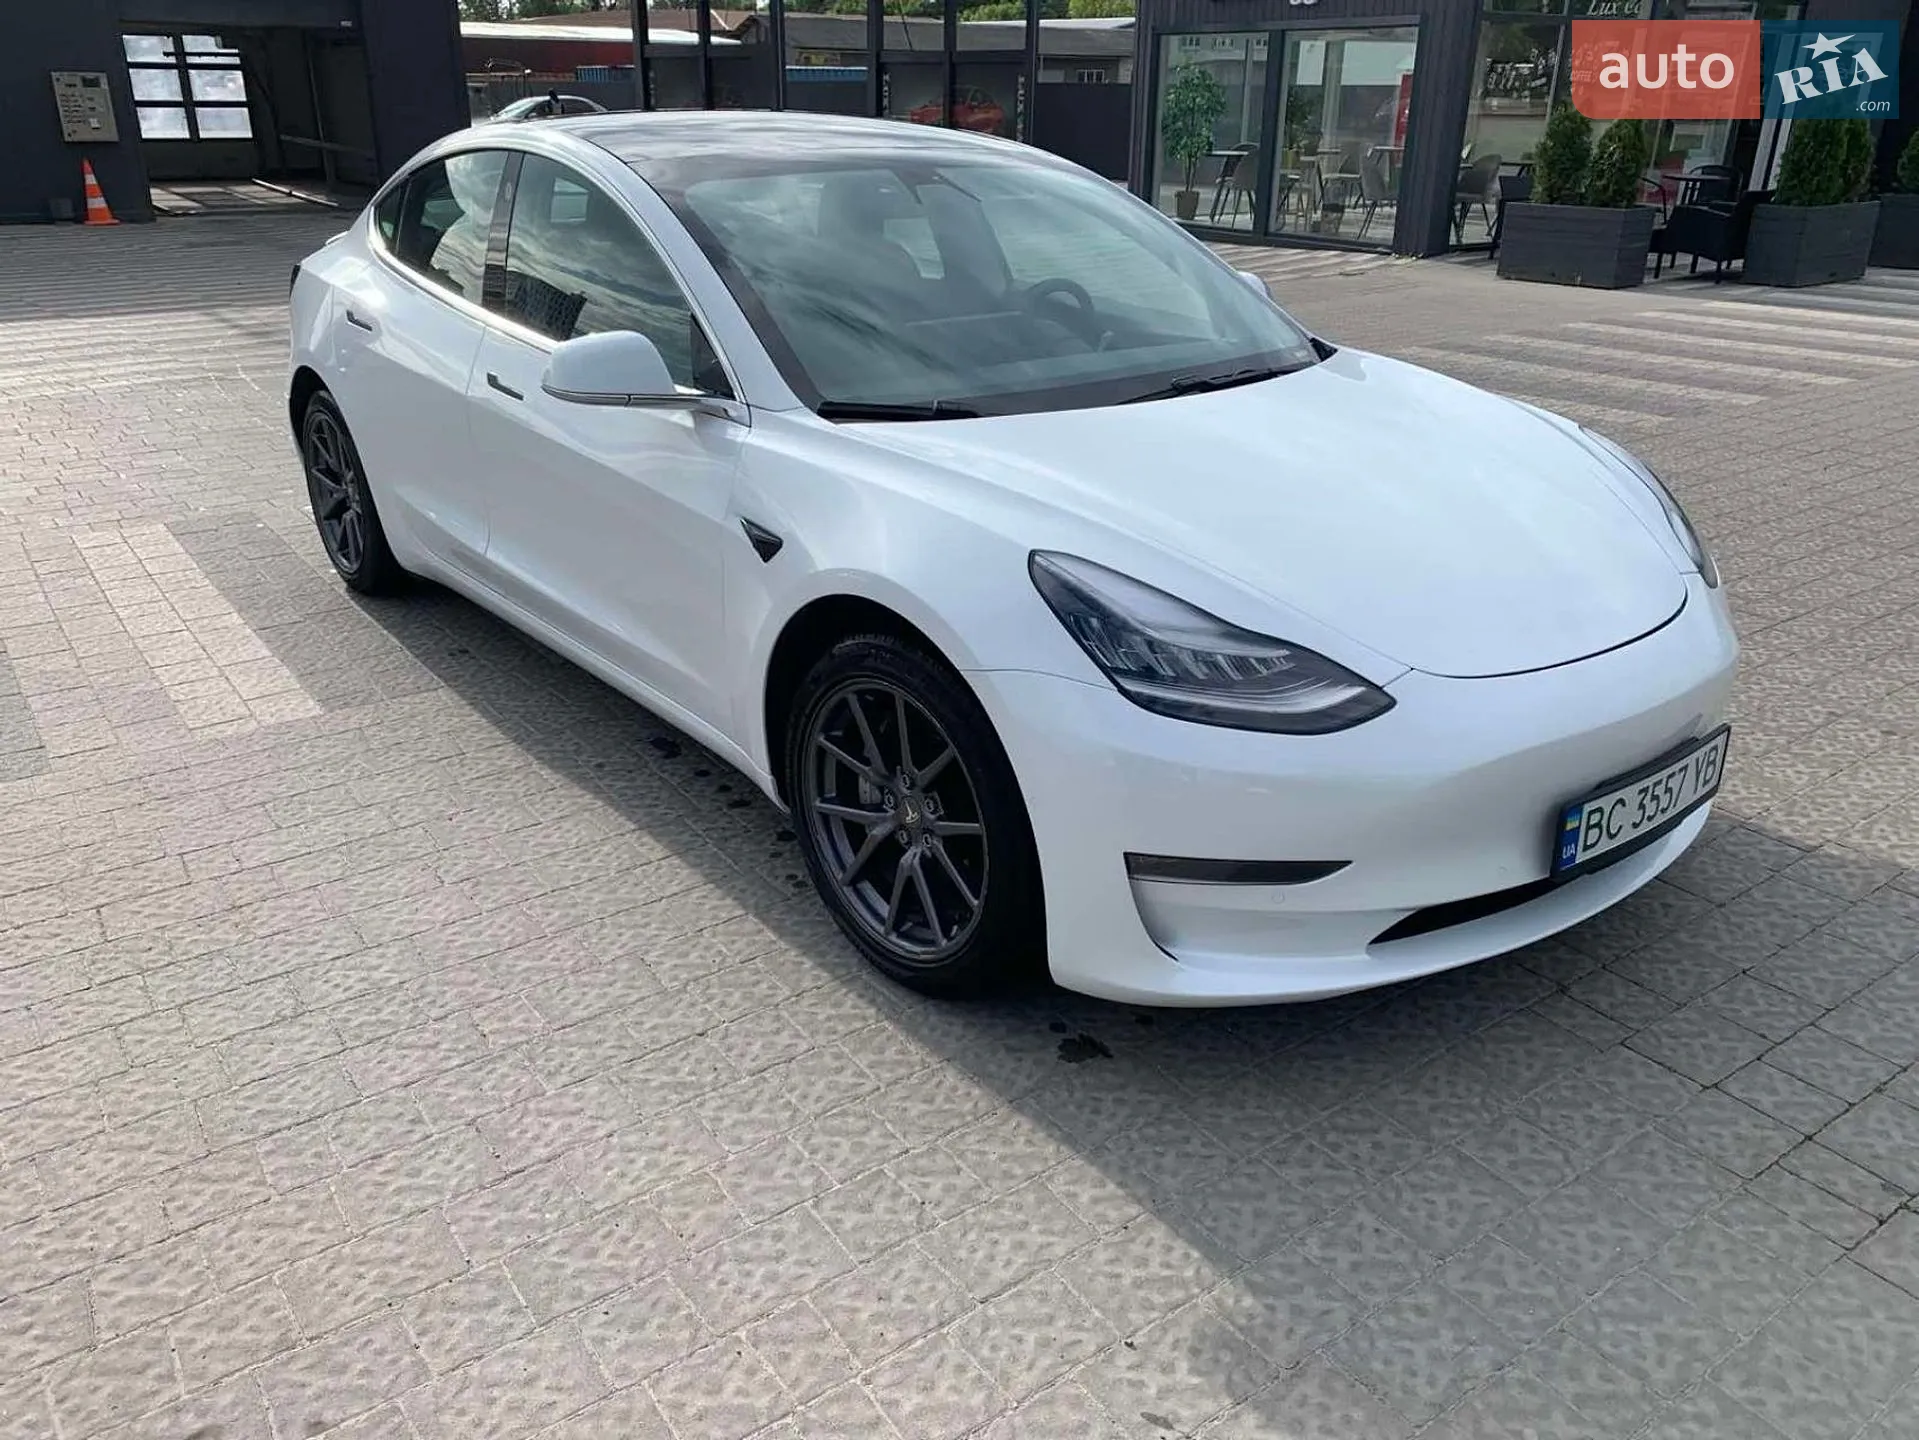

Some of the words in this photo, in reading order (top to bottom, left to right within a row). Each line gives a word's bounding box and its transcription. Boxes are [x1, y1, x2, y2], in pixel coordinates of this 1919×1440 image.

[1581, 797, 1627, 853] BC
[1630, 763, 1689, 830] 3557
[1692, 743, 1720, 795] YB
[1562, 843, 1576, 859] UA
